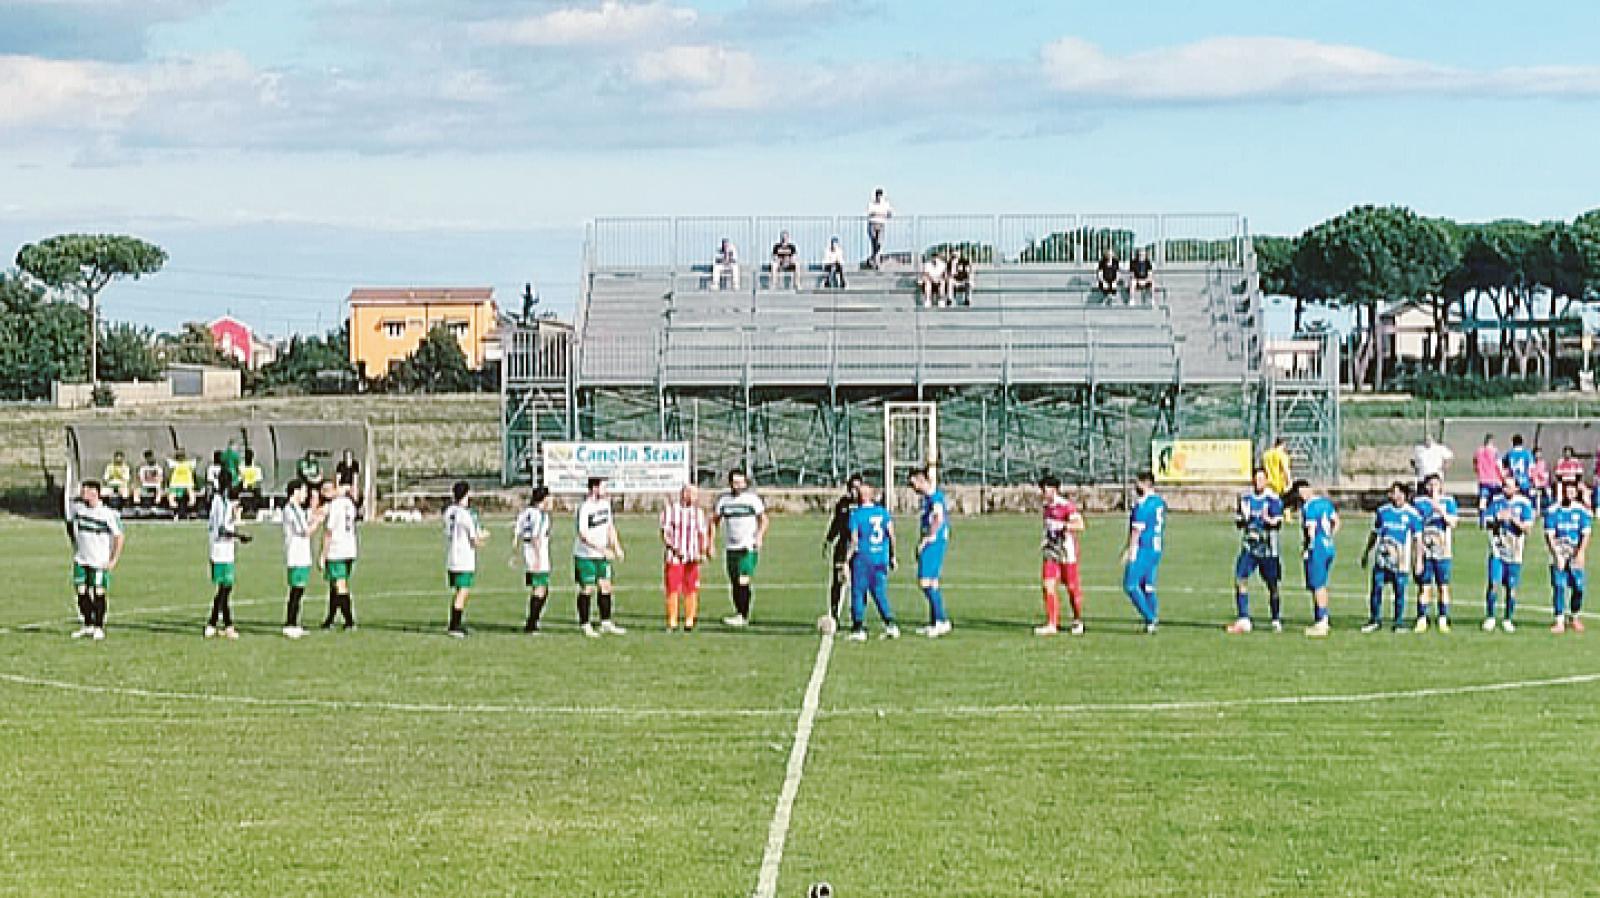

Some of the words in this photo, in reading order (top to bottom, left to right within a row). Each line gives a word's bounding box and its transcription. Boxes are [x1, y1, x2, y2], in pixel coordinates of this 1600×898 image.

[576, 445, 638, 462] Canella
[643, 445, 685, 462] Scavi
[869, 515, 883, 544] 3
